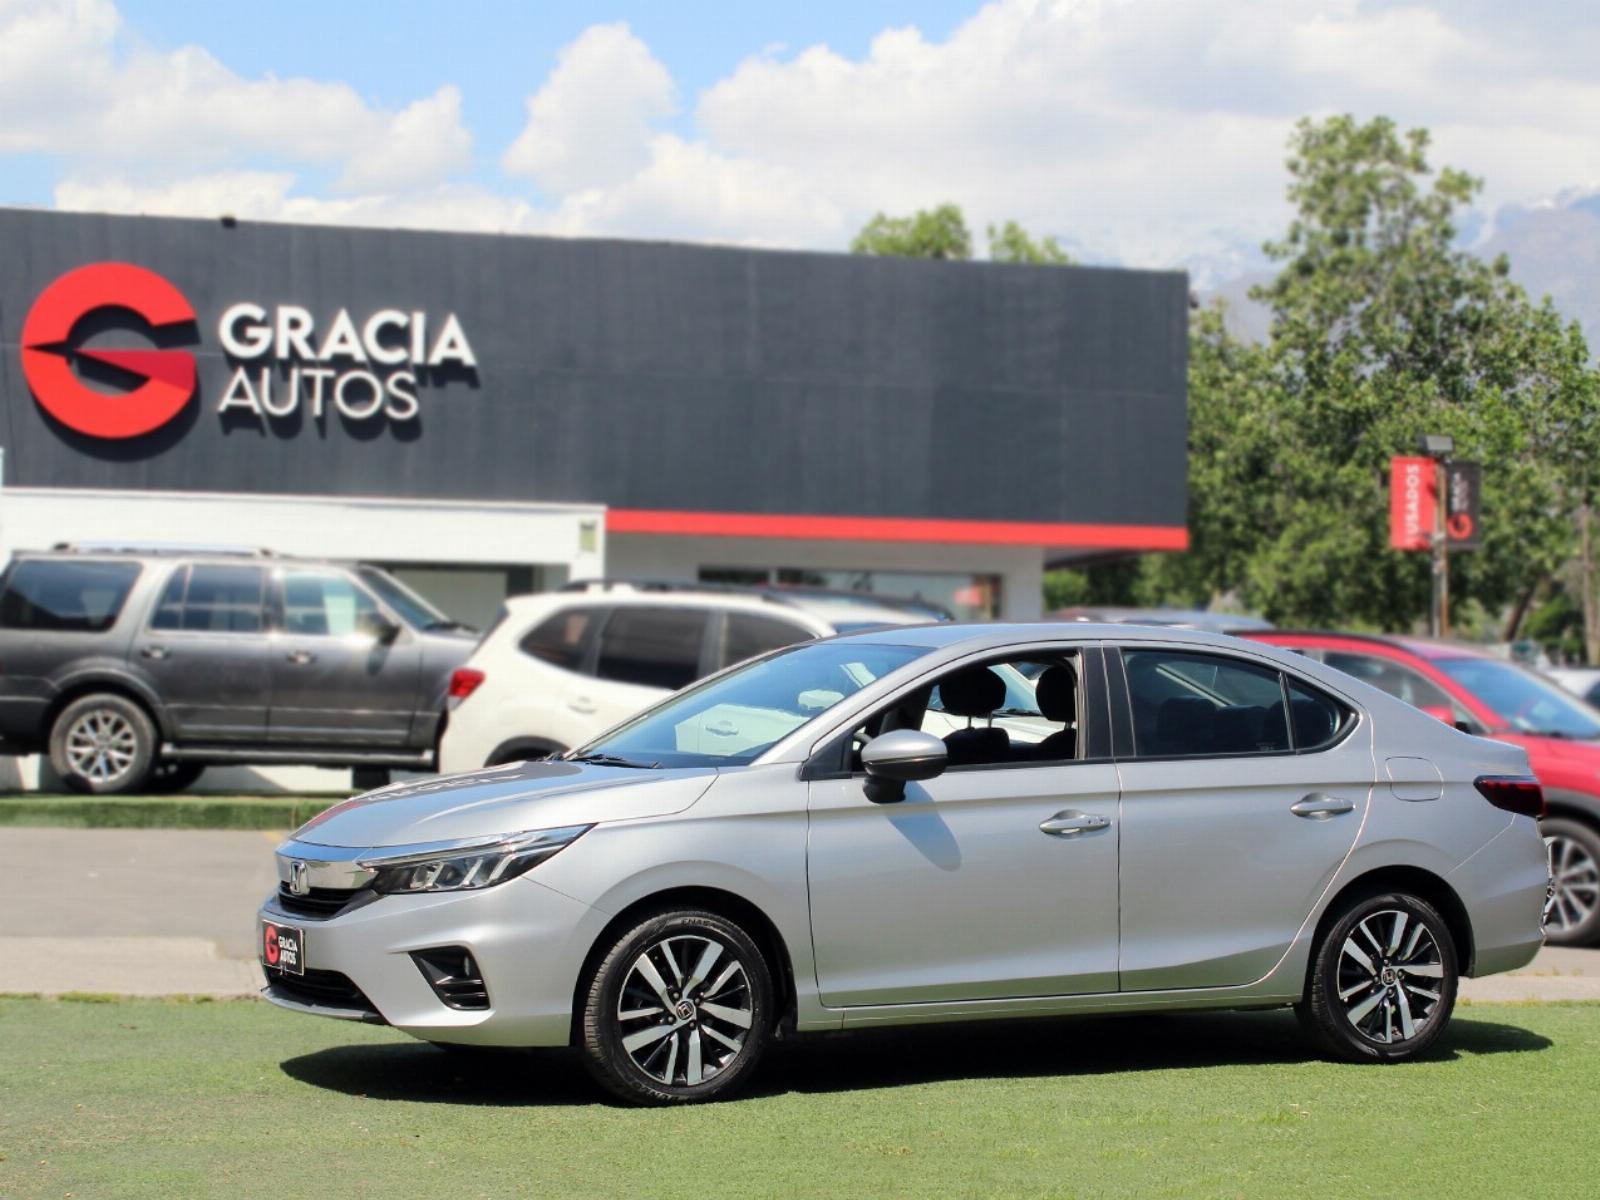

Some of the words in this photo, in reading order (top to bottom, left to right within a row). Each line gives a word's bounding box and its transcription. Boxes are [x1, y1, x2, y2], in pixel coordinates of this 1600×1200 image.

[218, 303, 476, 365] GRACIA
[218, 367, 419, 420] AUTOS
[1405, 464, 1420, 535] USADOS
